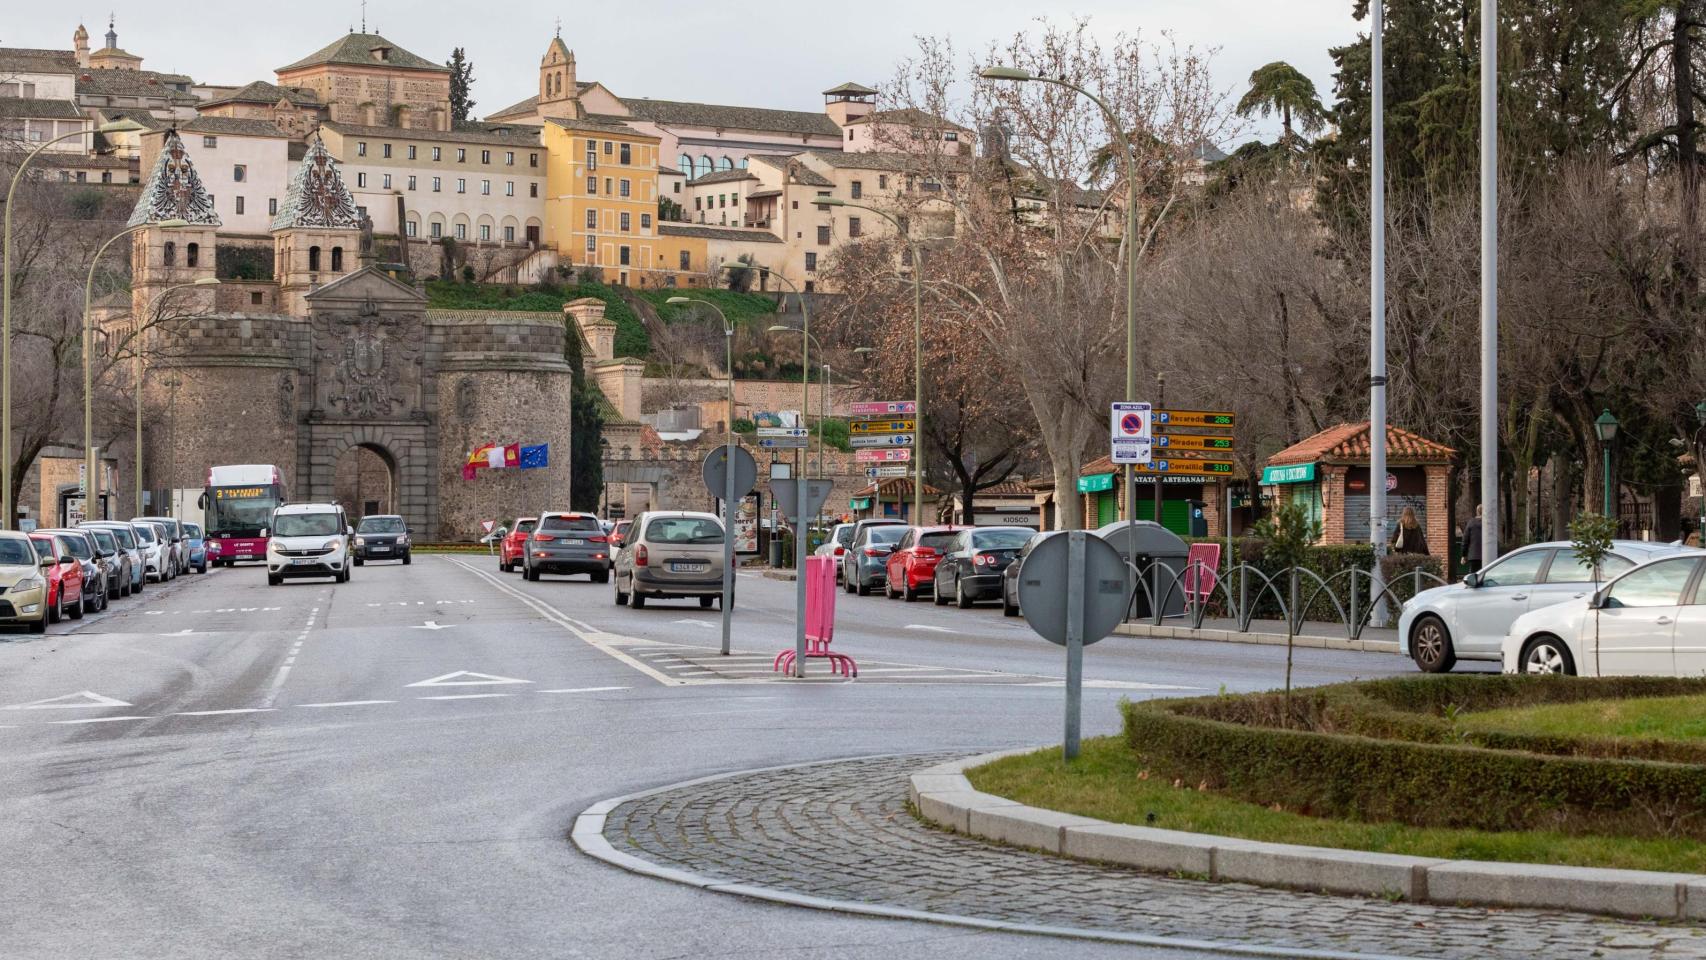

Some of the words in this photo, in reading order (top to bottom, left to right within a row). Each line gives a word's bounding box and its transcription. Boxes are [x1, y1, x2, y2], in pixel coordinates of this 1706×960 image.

[1160, 413, 1167, 422] P
[1171, 415, 1204, 423] Recaredo
[1215, 416, 1231, 424] 286
[1160, 437, 1167, 446] P
[1160, 461, 1167, 470] P
[1169, 462, 1203, 470] Corralillo
[216, 489, 223, 498] 3
[1194, 508, 1201, 518] P
